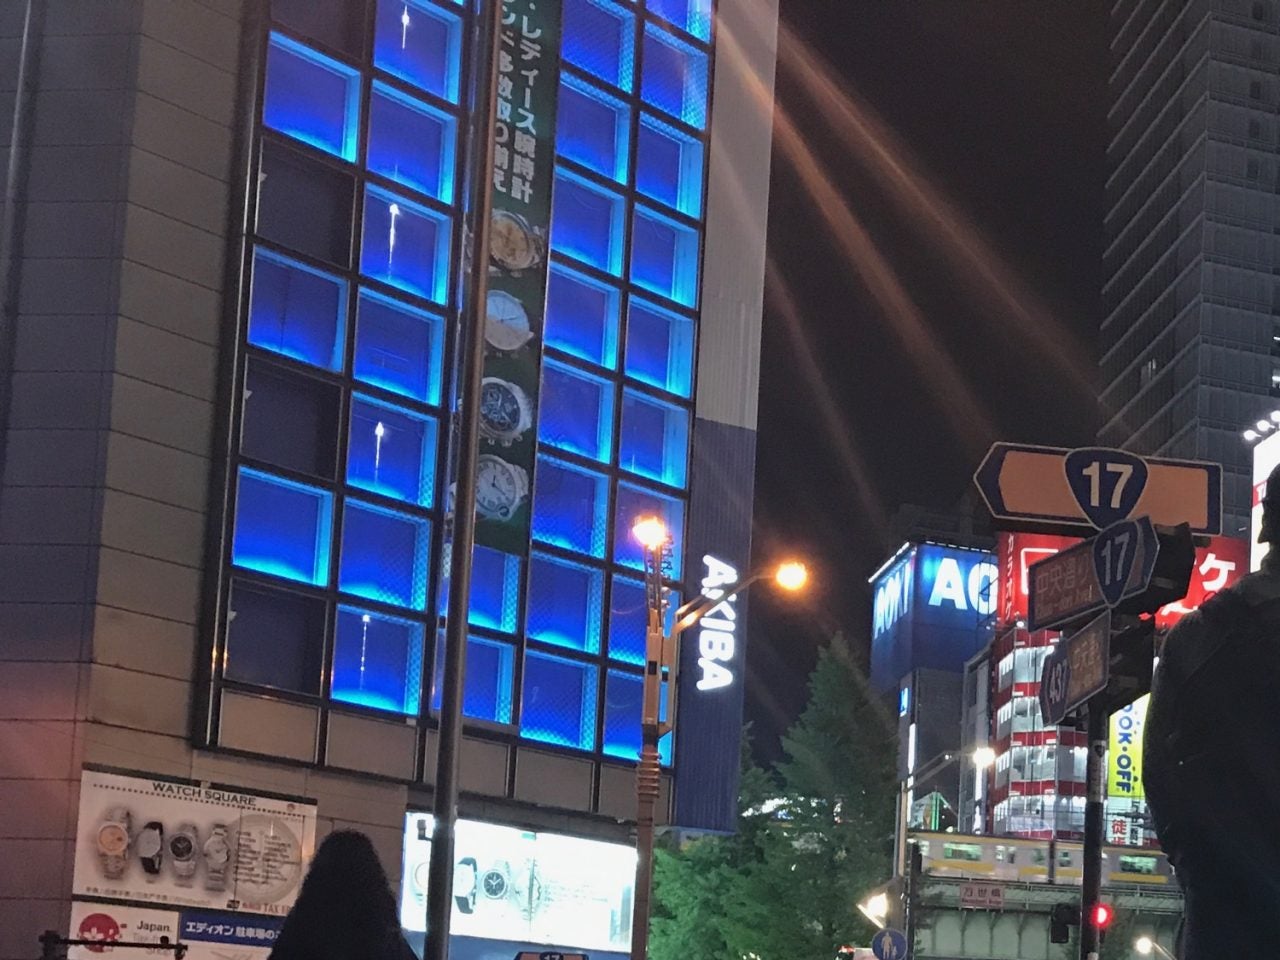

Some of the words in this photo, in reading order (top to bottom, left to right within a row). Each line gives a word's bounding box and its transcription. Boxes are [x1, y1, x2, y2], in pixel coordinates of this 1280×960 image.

[1082, 463, 1133, 509] 17
[1036, 553, 1091, 600] 中央通り
[1102, 531, 1130, 586] 17
[696, 554, 738, 691] AKIBA
[152, 782, 201, 798] WATCH
[204, 790, 256, 806] SQUARE
[186, 922, 234, 936] エディオン
